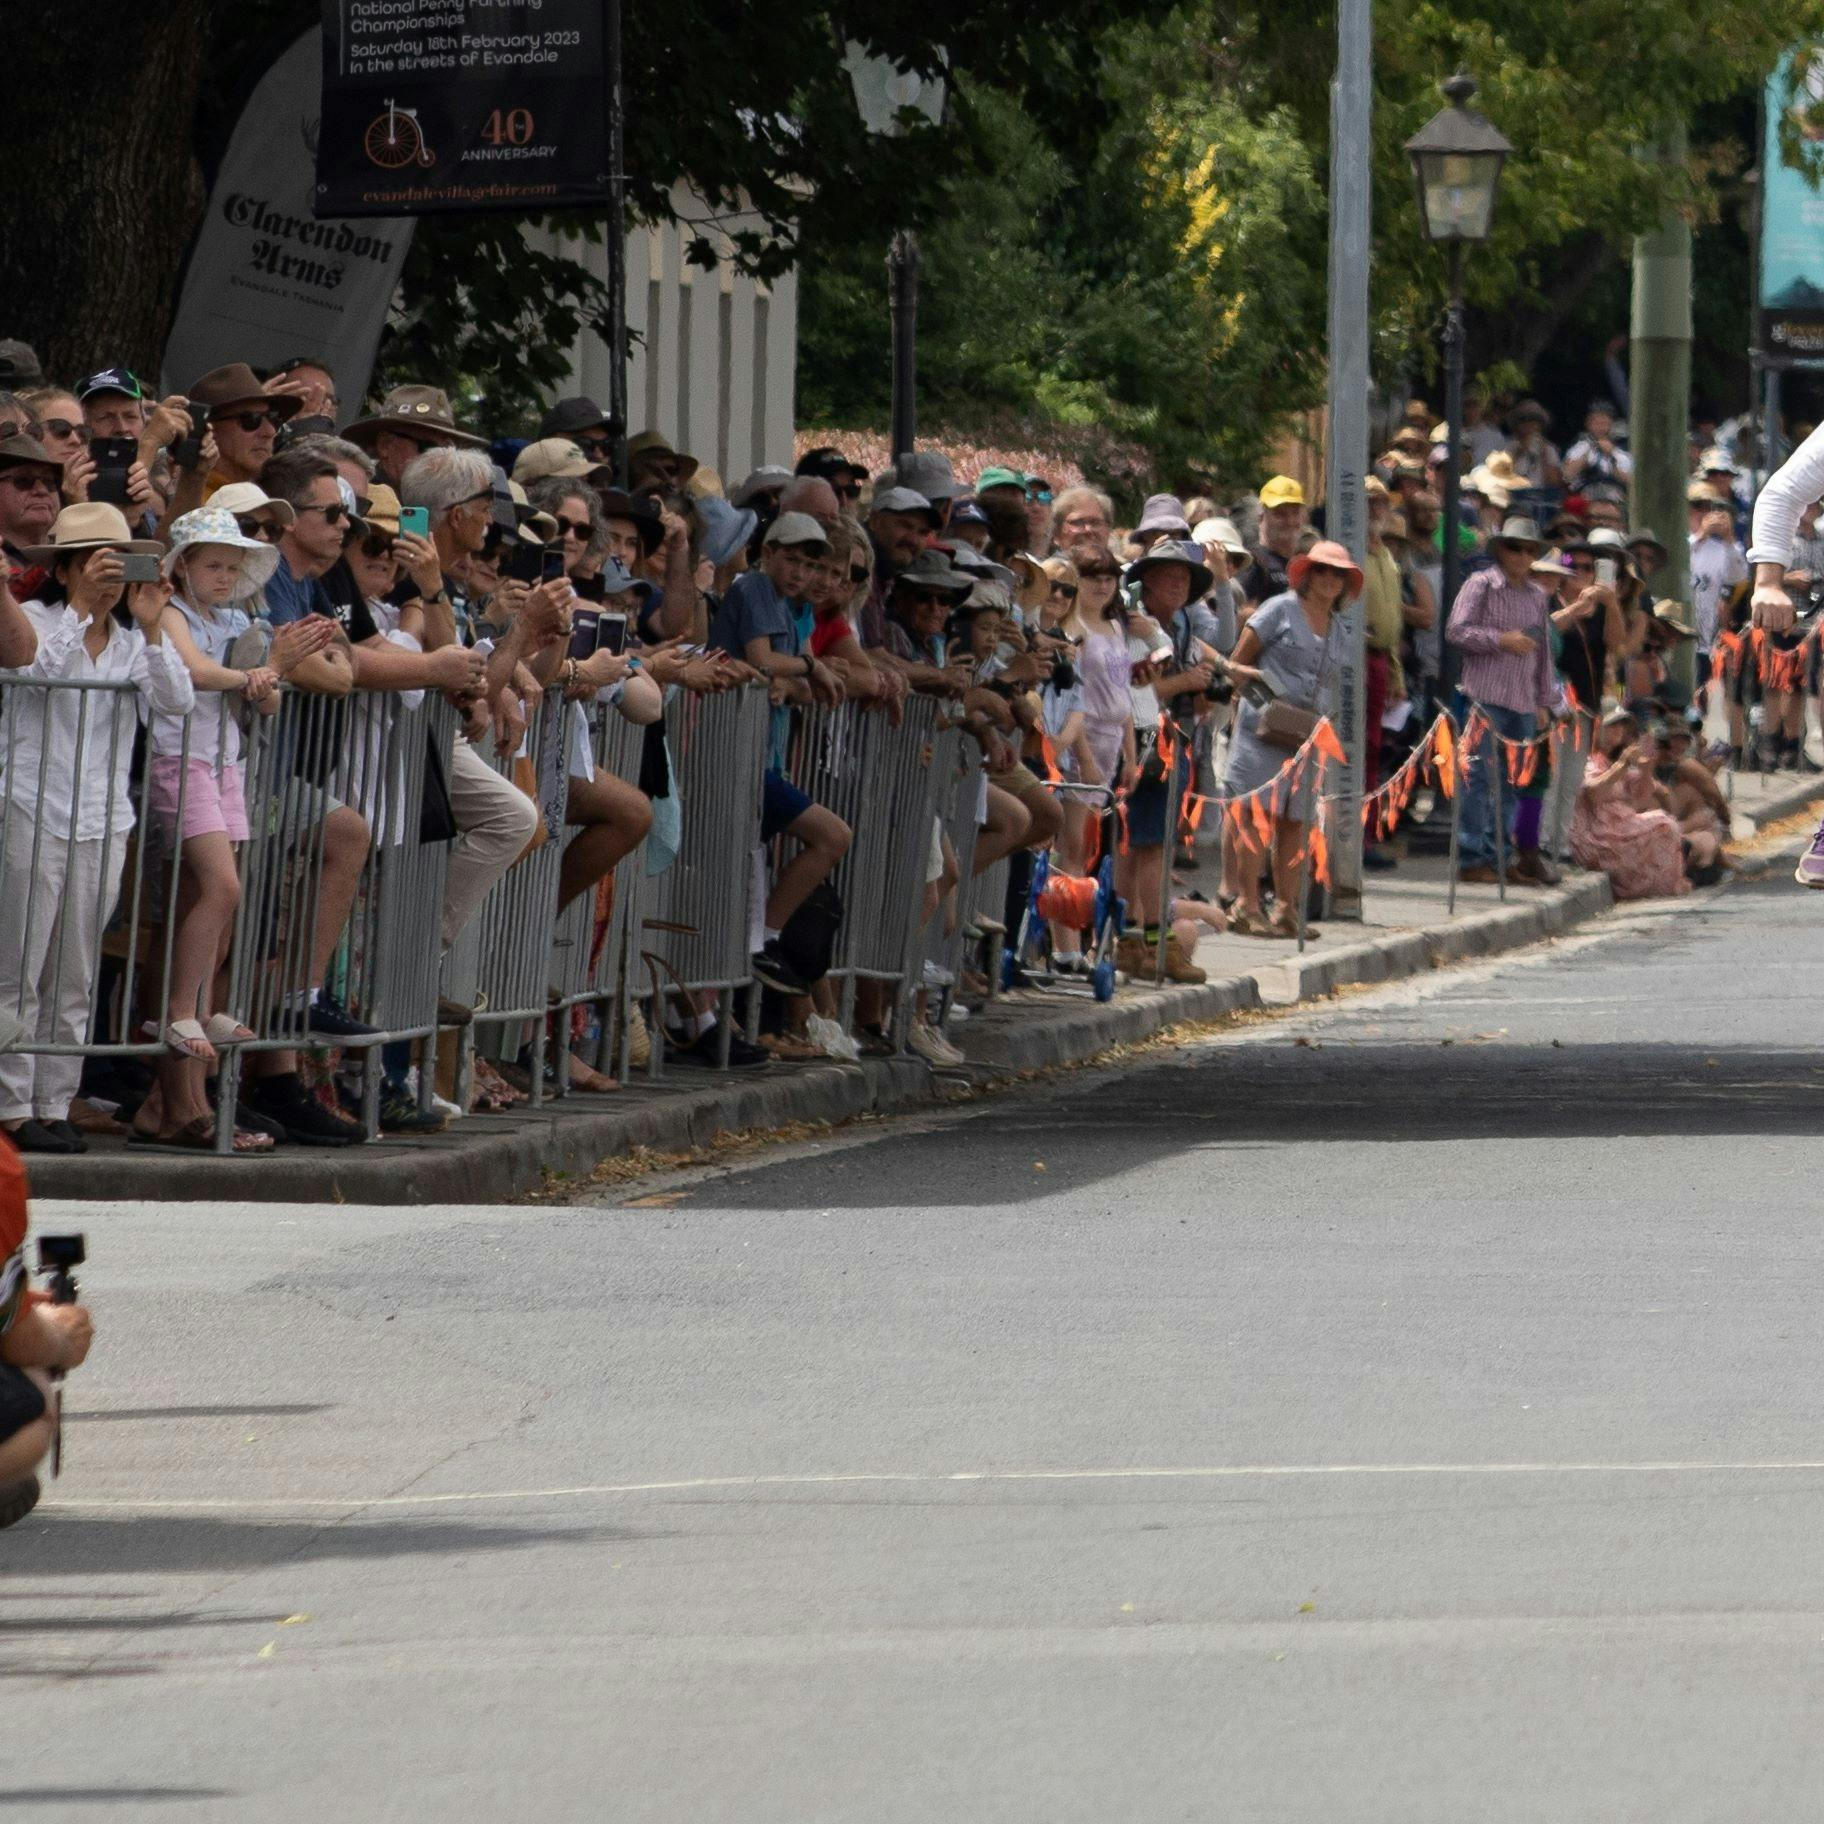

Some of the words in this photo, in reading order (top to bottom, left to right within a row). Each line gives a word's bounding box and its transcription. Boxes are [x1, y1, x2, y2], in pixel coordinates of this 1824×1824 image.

[351, 0, 416, 16] National
[351, 12, 465, 34] Championships
[350, 40, 423, 58] Saturday
[428, 36, 458, 50] 18th
[462, 32, 540, 50] February
[544, 31, 580, 46] 2023
[367, 57, 394, 72] the
[397, 54, 455, 70] streets
[459, 52, 479, 67] of
[483, 49, 559, 66] Evandale
[480, 106, 536, 147] 40
[460, 145, 558, 162] ANNIVERSARY
[362, 183, 557, 203] evandalevillagefair.com
[223, 192, 393, 264] Clarendon
[250, 239, 346, 290] Arms
